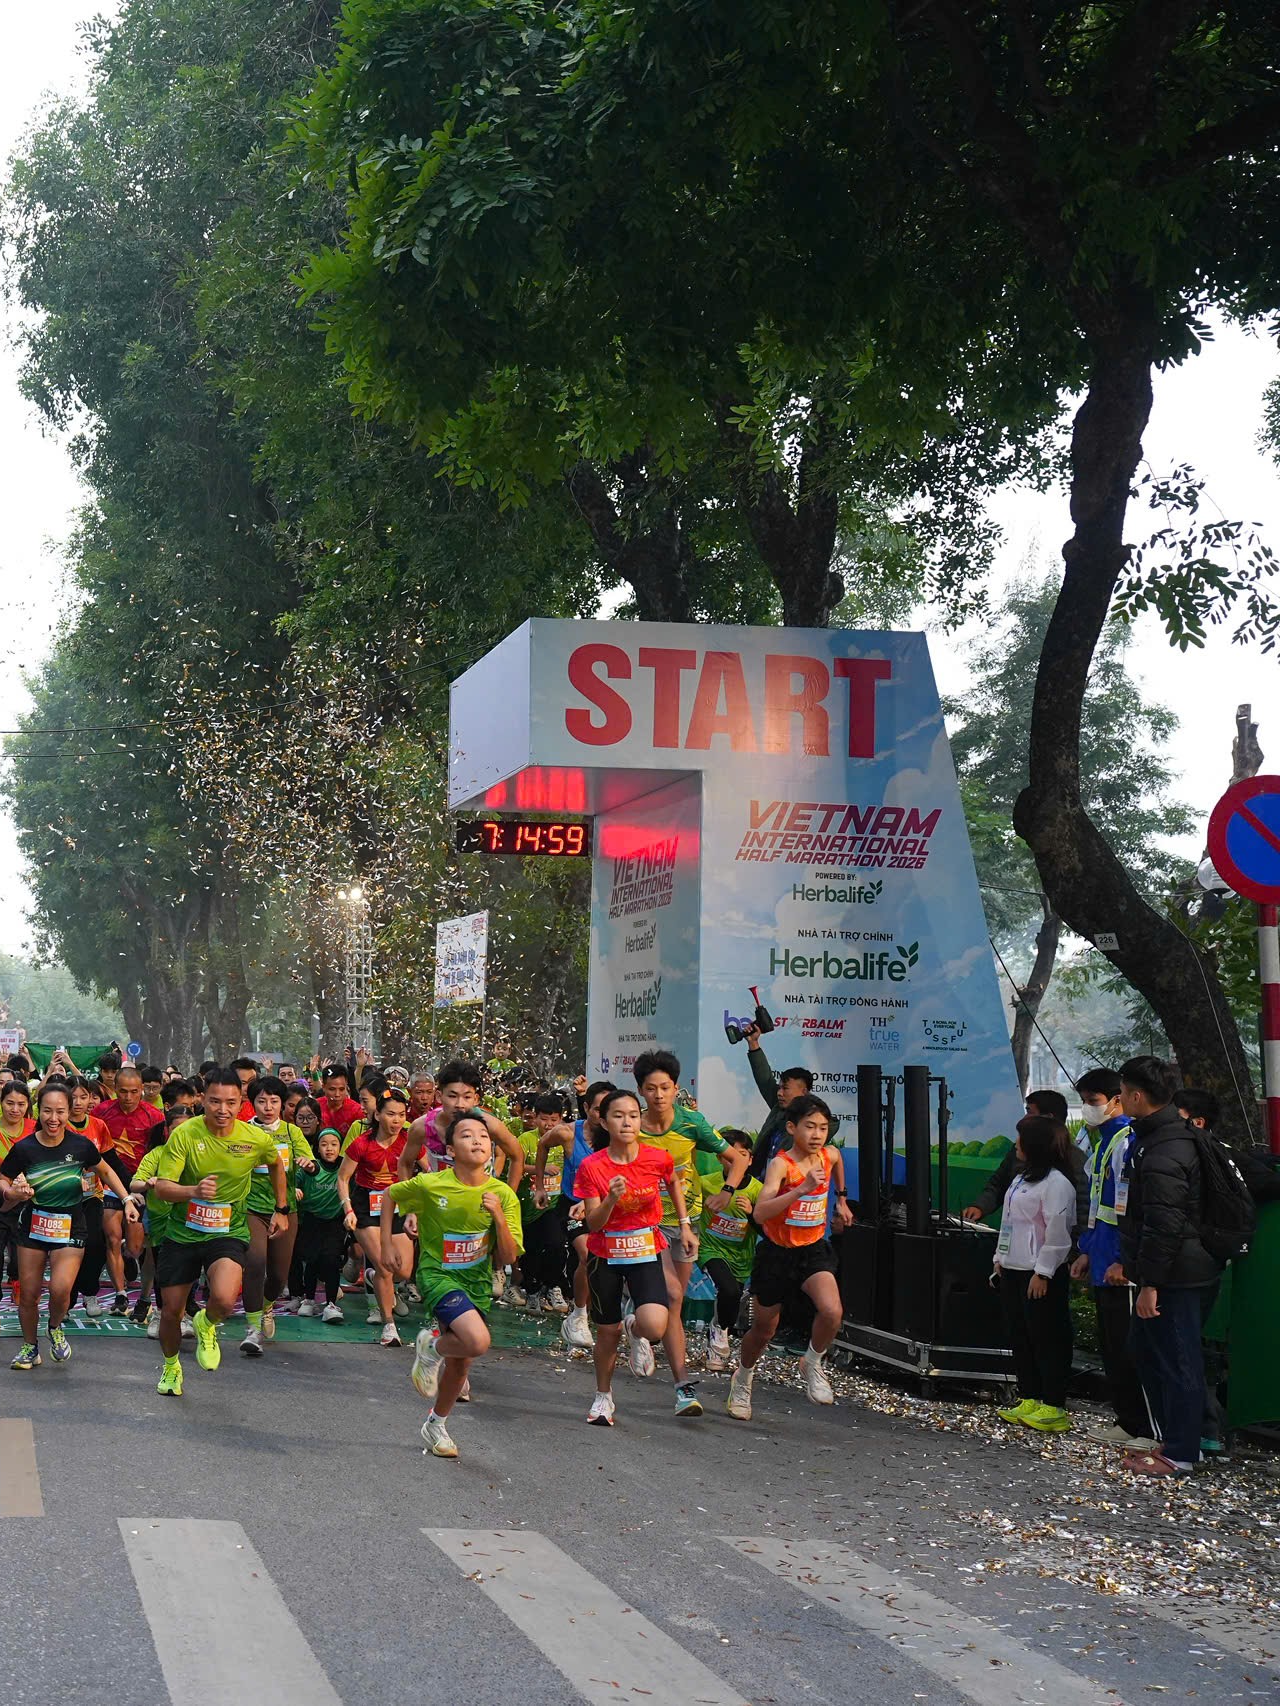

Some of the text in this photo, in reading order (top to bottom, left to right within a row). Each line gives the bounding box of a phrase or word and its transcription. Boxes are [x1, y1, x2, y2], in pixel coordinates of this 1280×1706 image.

[564, 642, 892, 759] START
[749, 799, 943, 838] VIETNAM
[483, 823, 584, 854] 7:14:59
[740, 831, 930, 856] INTERNATIONAL
[613, 835, 679, 887] VIETNAM
[735, 848, 927, 869] HALF MARATHON 2026
[815, 872, 857, 881] POWERED BY:
[610, 870, 674, 906] INTERNATIONAL
[792, 883, 876, 905] Herbalife
[624, 930, 654, 954] Herbalife
[797, 927, 894, 942] NHÀ TÀI TRỢ CHÍNH
[1099, 936, 1114, 944] 226
[770, 947, 907, 982] Herbalife
[615, 988, 657, 1019] Herbalife
[784, 993, 805, 1004] NHÀ
[807, 993, 824, 1005] TÀI
[826, 996, 848, 1007] TRỢ
[881, 996, 909, 1008] HÀNH
[869, 1016, 887, 1027] TH
[801, 1030, 843, 1039] SPORT CARE
[869, 1027, 900, 1042] true
[869, 1042, 900, 1051] WATER
[601, 1052, 610, 1074] be
[821, 1072, 841, 1083] TRỢ
[809, 1084, 858, 1094] EDIA SUPPO
[195, 1205, 223, 1218] F1064
[38, 1217, 63, 1229] F1082
[615, 1236, 646, 1249] F1053
